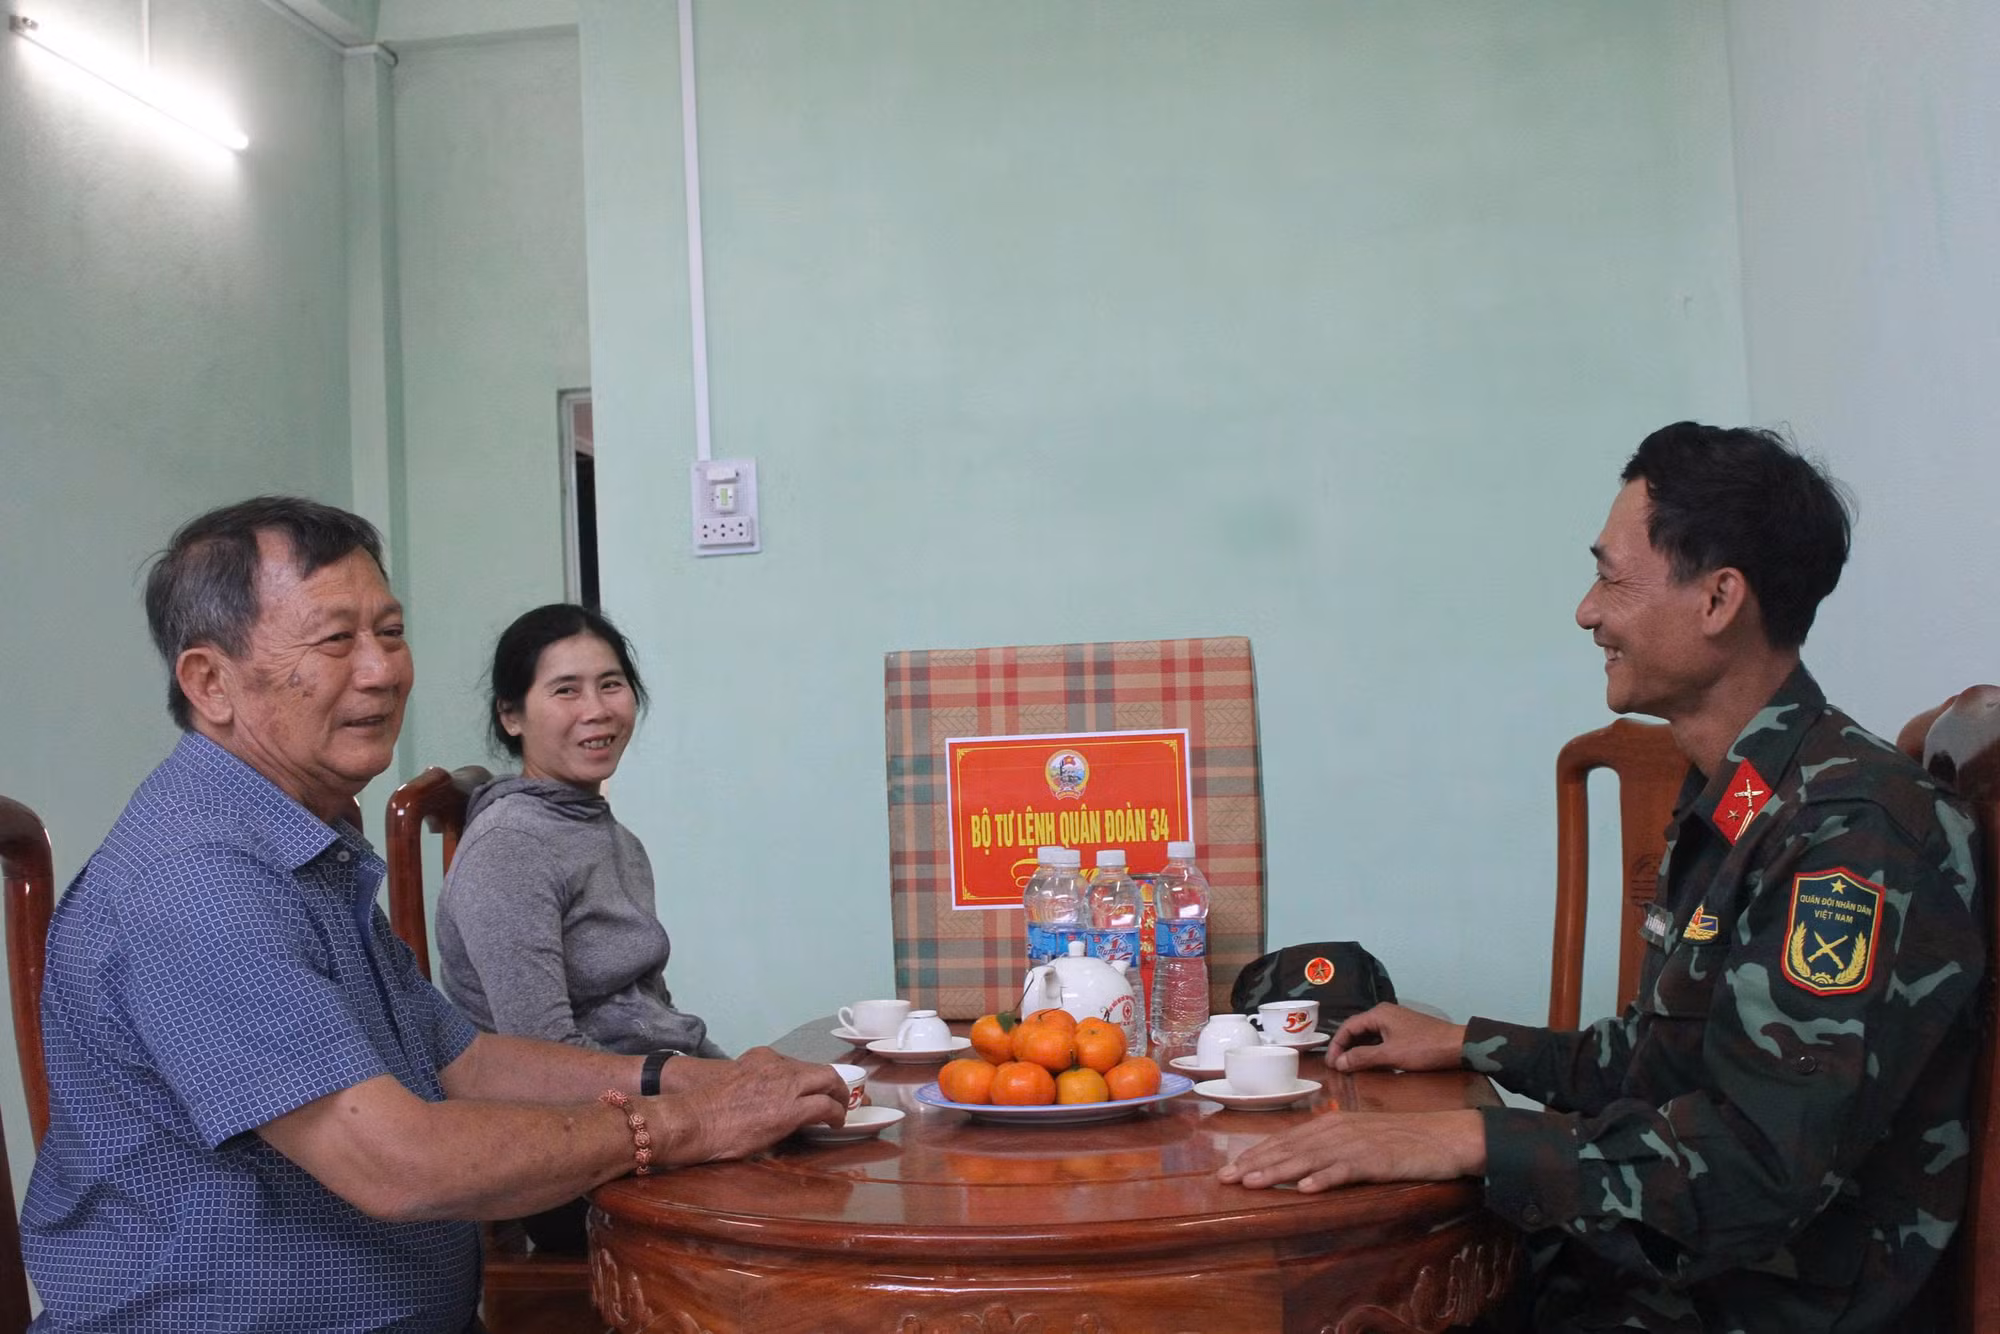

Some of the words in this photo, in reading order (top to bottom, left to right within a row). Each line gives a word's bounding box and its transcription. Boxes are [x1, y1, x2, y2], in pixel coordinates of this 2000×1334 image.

[971, 807, 992, 855] BỘ
[994, 809, 1015, 848] TƯ
[1017, 805, 1056, 854] LỆNH
[1060, 803, 1101, 848] QUÂN
[1104, 801, 1147, 843] ĐOÀN
[1150, 808, 1169, 842] 34
[1800, 894, 1820, 905] QUÂN
[1835, 900, 1856, 911] NHÂN
[1814, 909, 1833, 920] VIỆT
[1834, 913, 1854, 923] NAM
